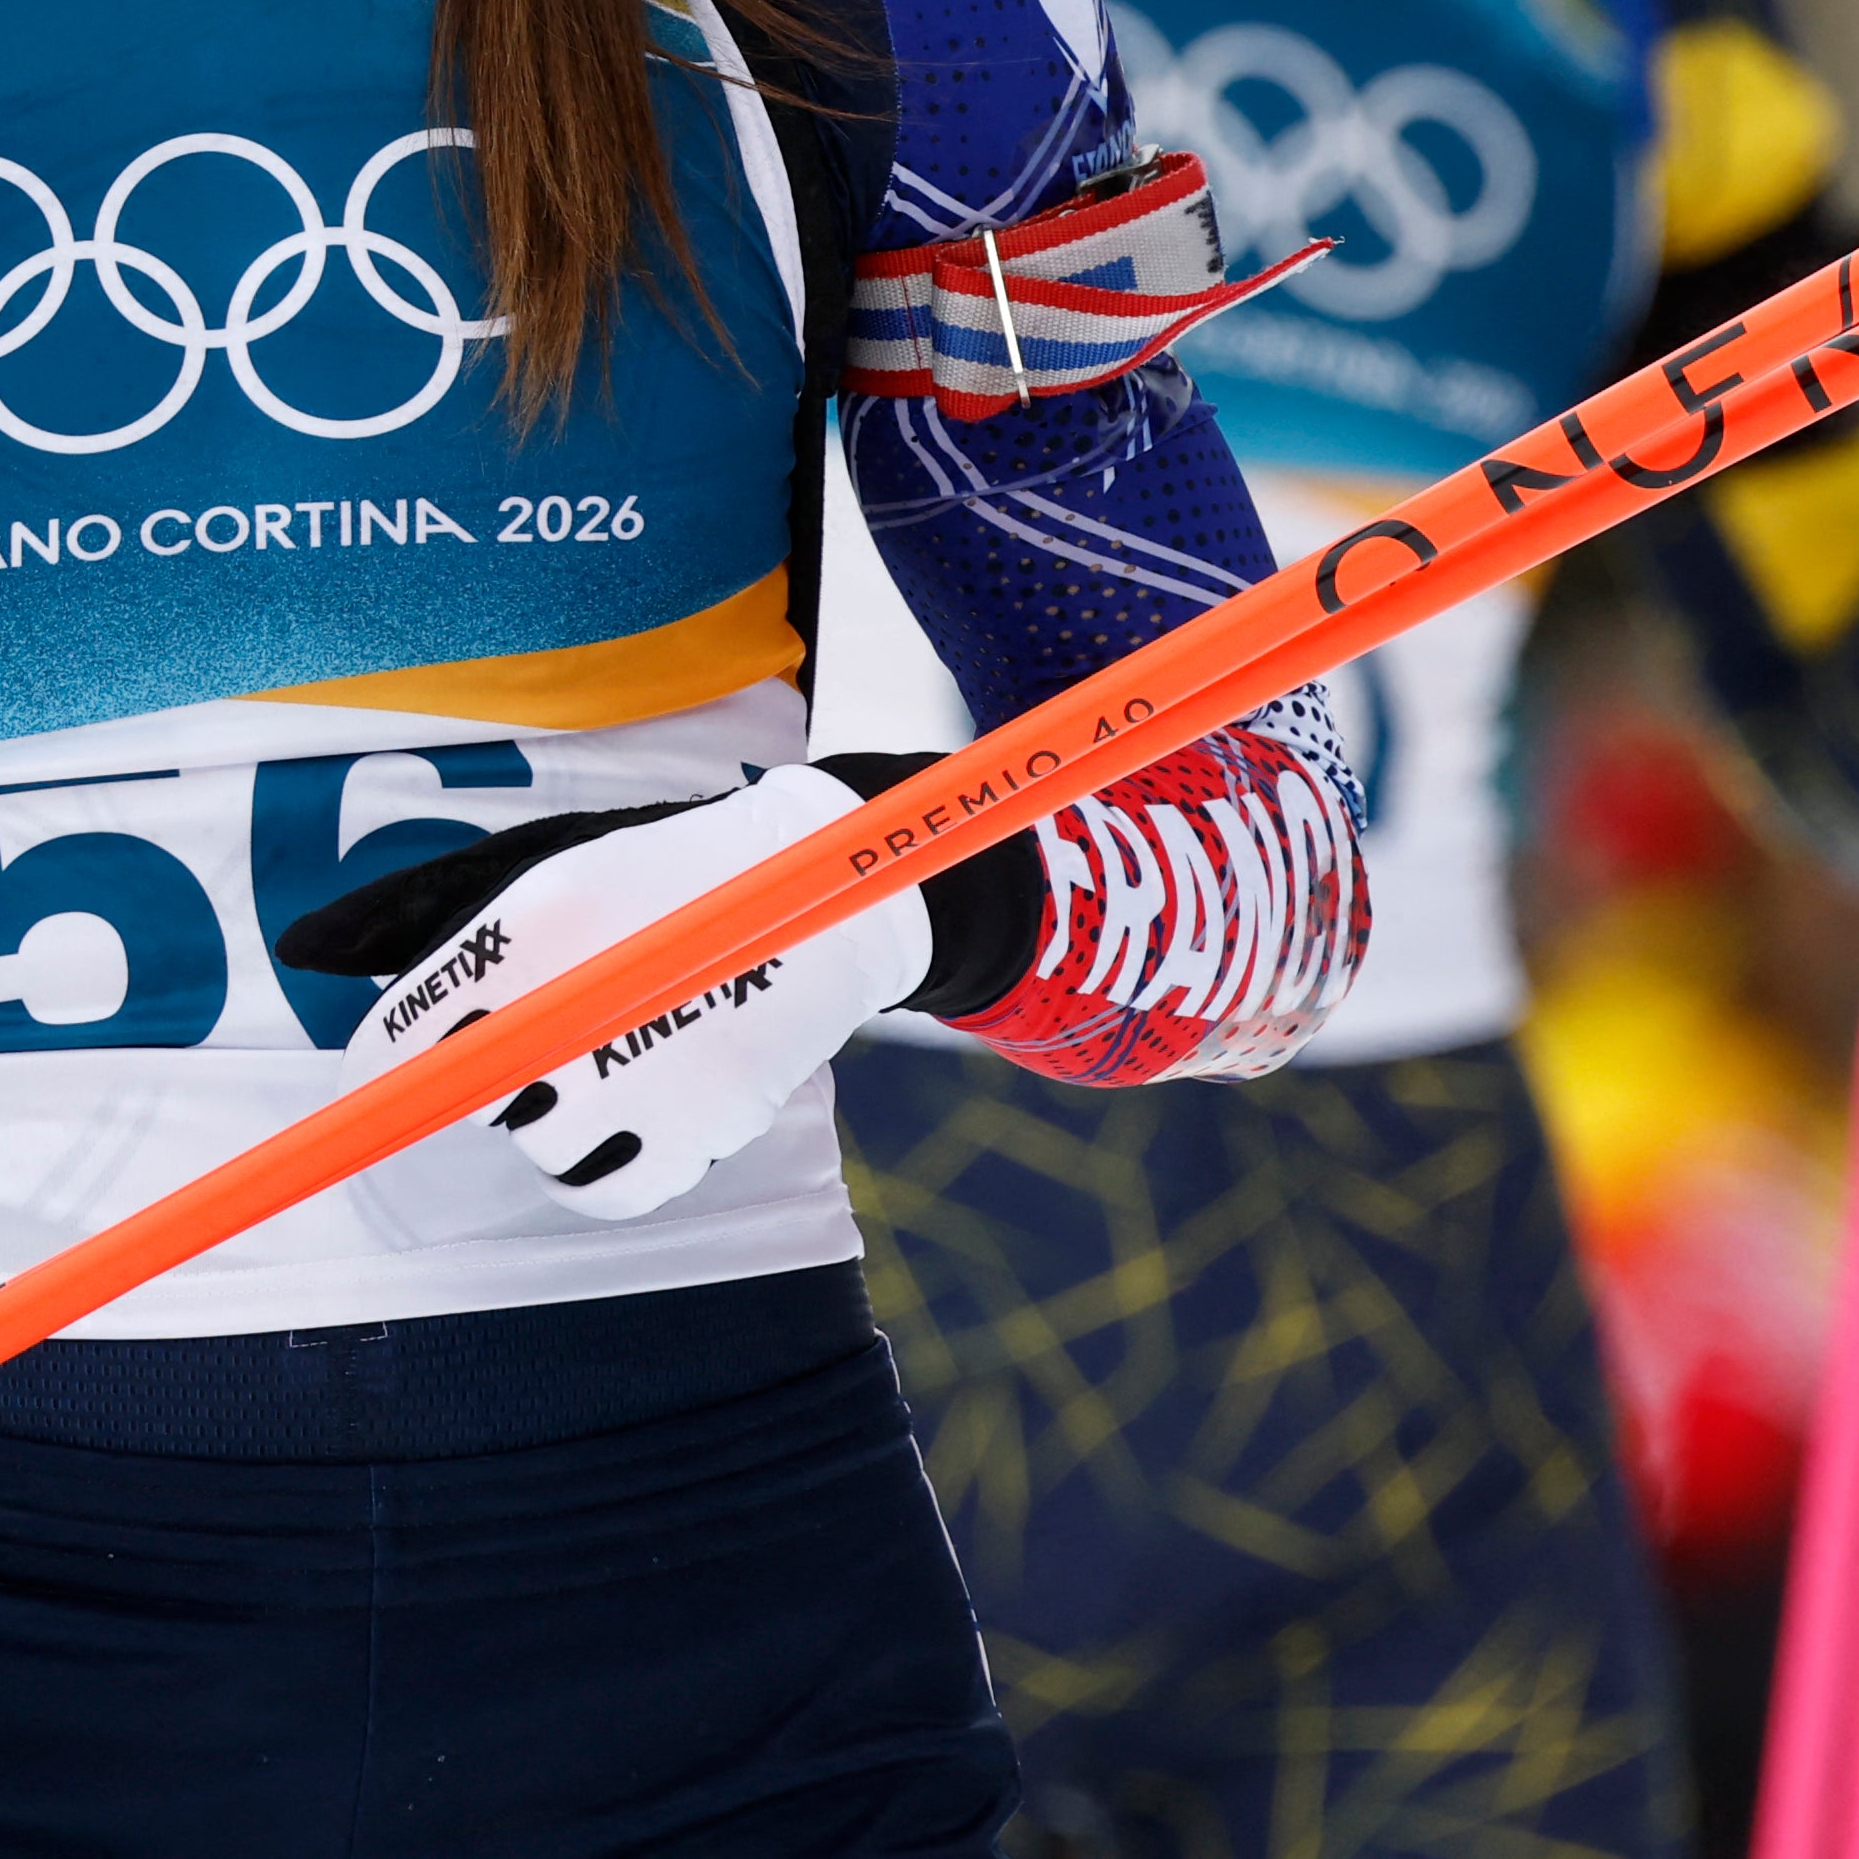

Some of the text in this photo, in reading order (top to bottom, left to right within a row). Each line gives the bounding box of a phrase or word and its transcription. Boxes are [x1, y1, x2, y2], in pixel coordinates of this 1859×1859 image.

[140, 498, 478, 558] CORTINA
[496, 494, 646, 544] 2026
[849, 698, 1154, 876] PREMIO 40
[382, 919, 512, 1043] KINETIXX
